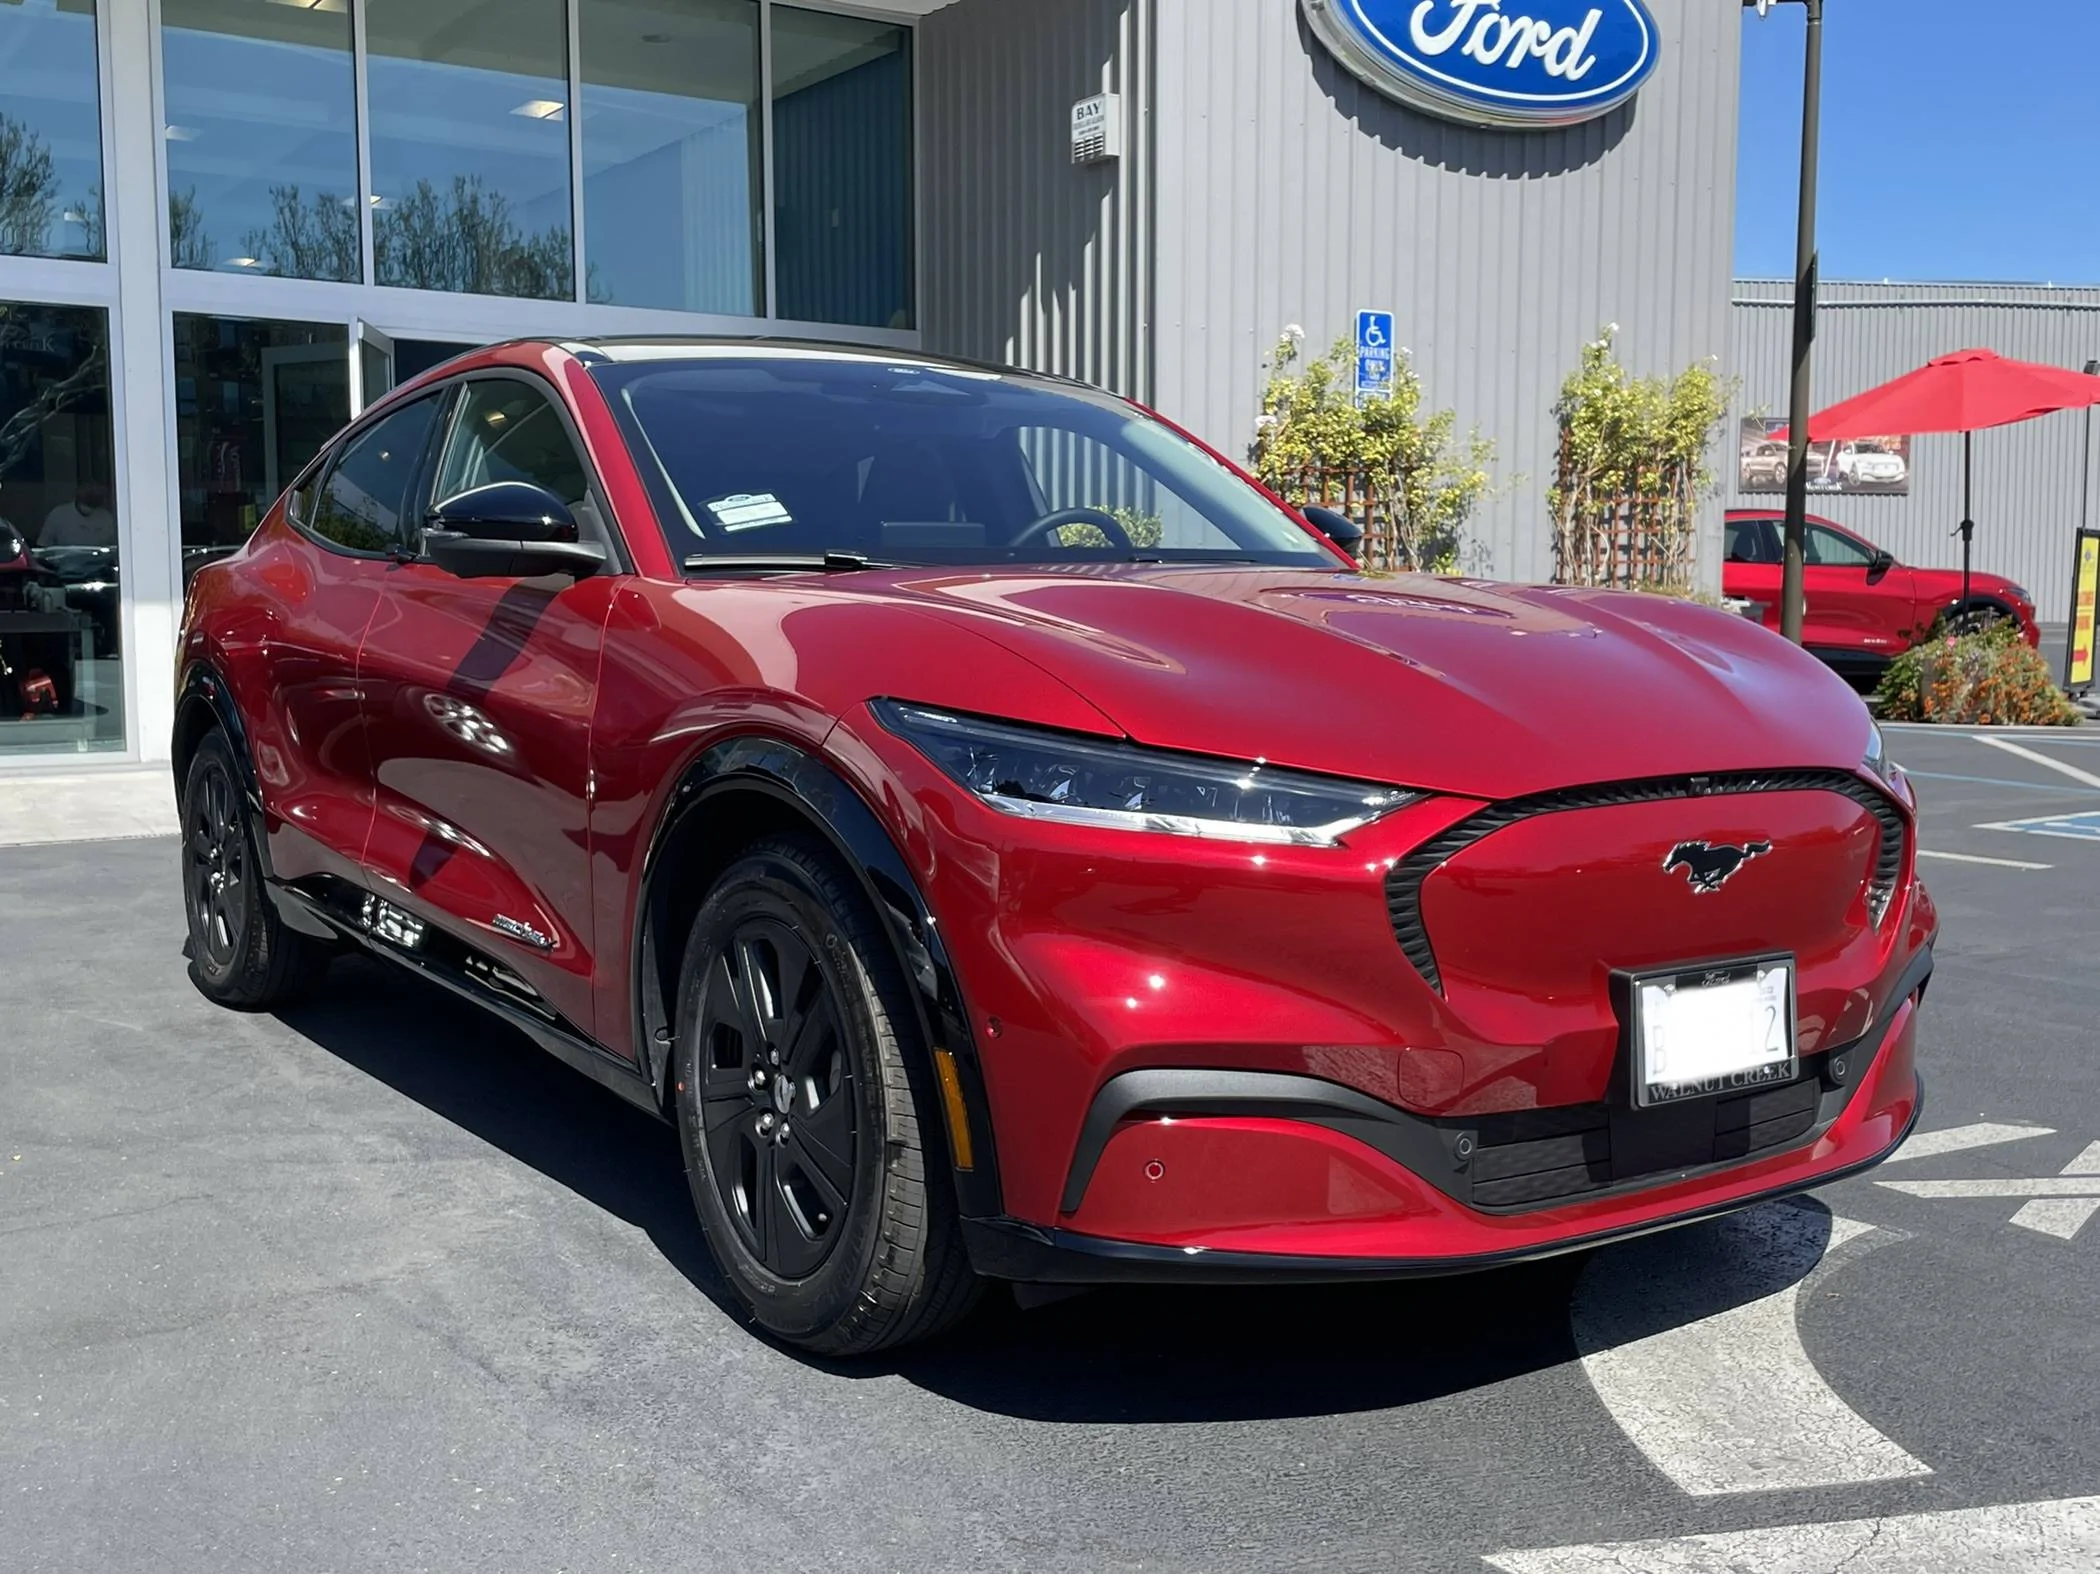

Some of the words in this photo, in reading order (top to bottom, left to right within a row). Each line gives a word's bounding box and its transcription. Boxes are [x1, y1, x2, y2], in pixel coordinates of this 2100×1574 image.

[1410, 0, 1604, 82] Ford
[1077, 102, 1101, 120] BAY
[1360, 345, 1390, 360] PARKING
[1650, 1076, 1727, 1100] WALNUT
[1731, 1061, 1792, 1086] CREEK
